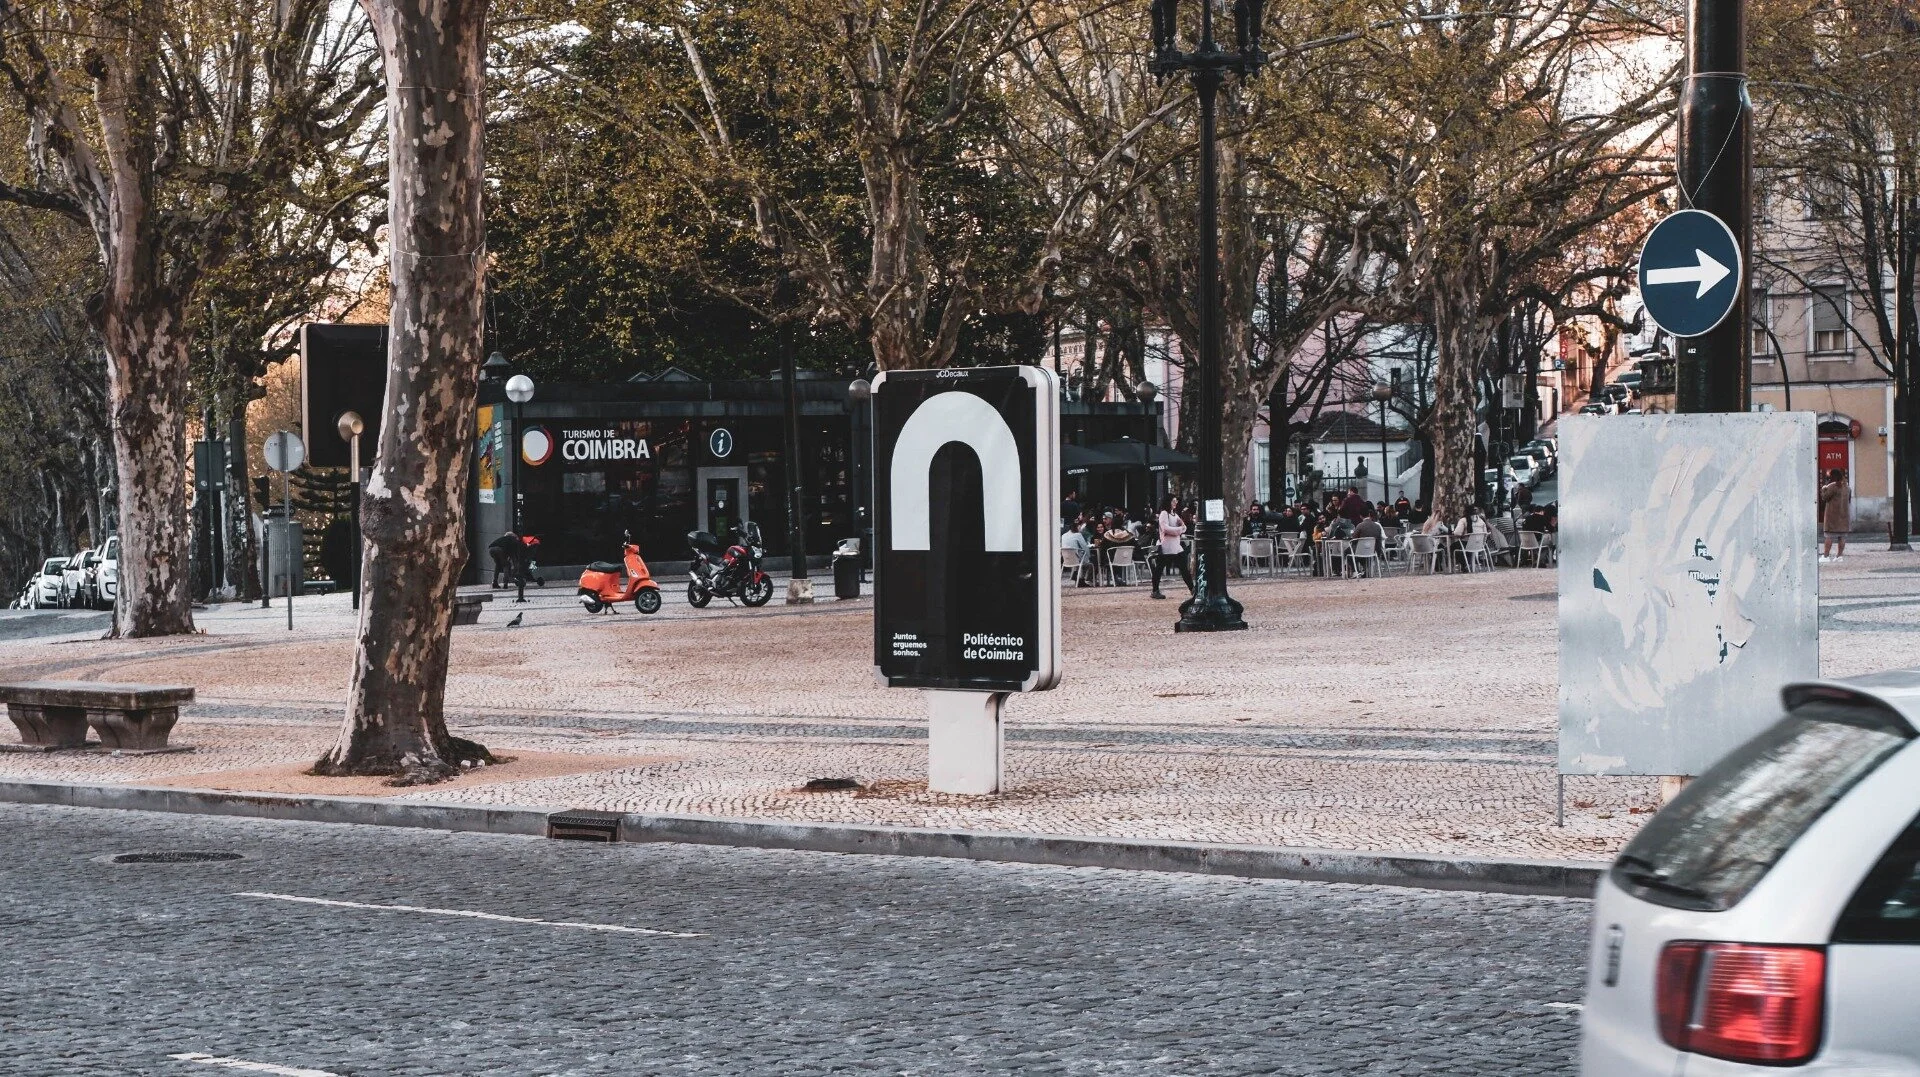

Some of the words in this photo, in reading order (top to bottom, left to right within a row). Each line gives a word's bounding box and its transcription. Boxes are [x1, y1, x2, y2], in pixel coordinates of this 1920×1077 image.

[936, 369, 969, 379] JCDecaux
[562, 429, 600, 439] TURISMO
[603, 429, 615, 438] DE
[562, 438, 650, 460] COIMBRA
[893, 632, 917, 640] Juntos
[963, 633, 1024, 646] Politécnico
[893, 641, 928, 650] erguemos
[893, 649, 921, 657] sonhos.
[963, 647, 978, 659] de
[978, 647, 1024, 661] Coimbra
